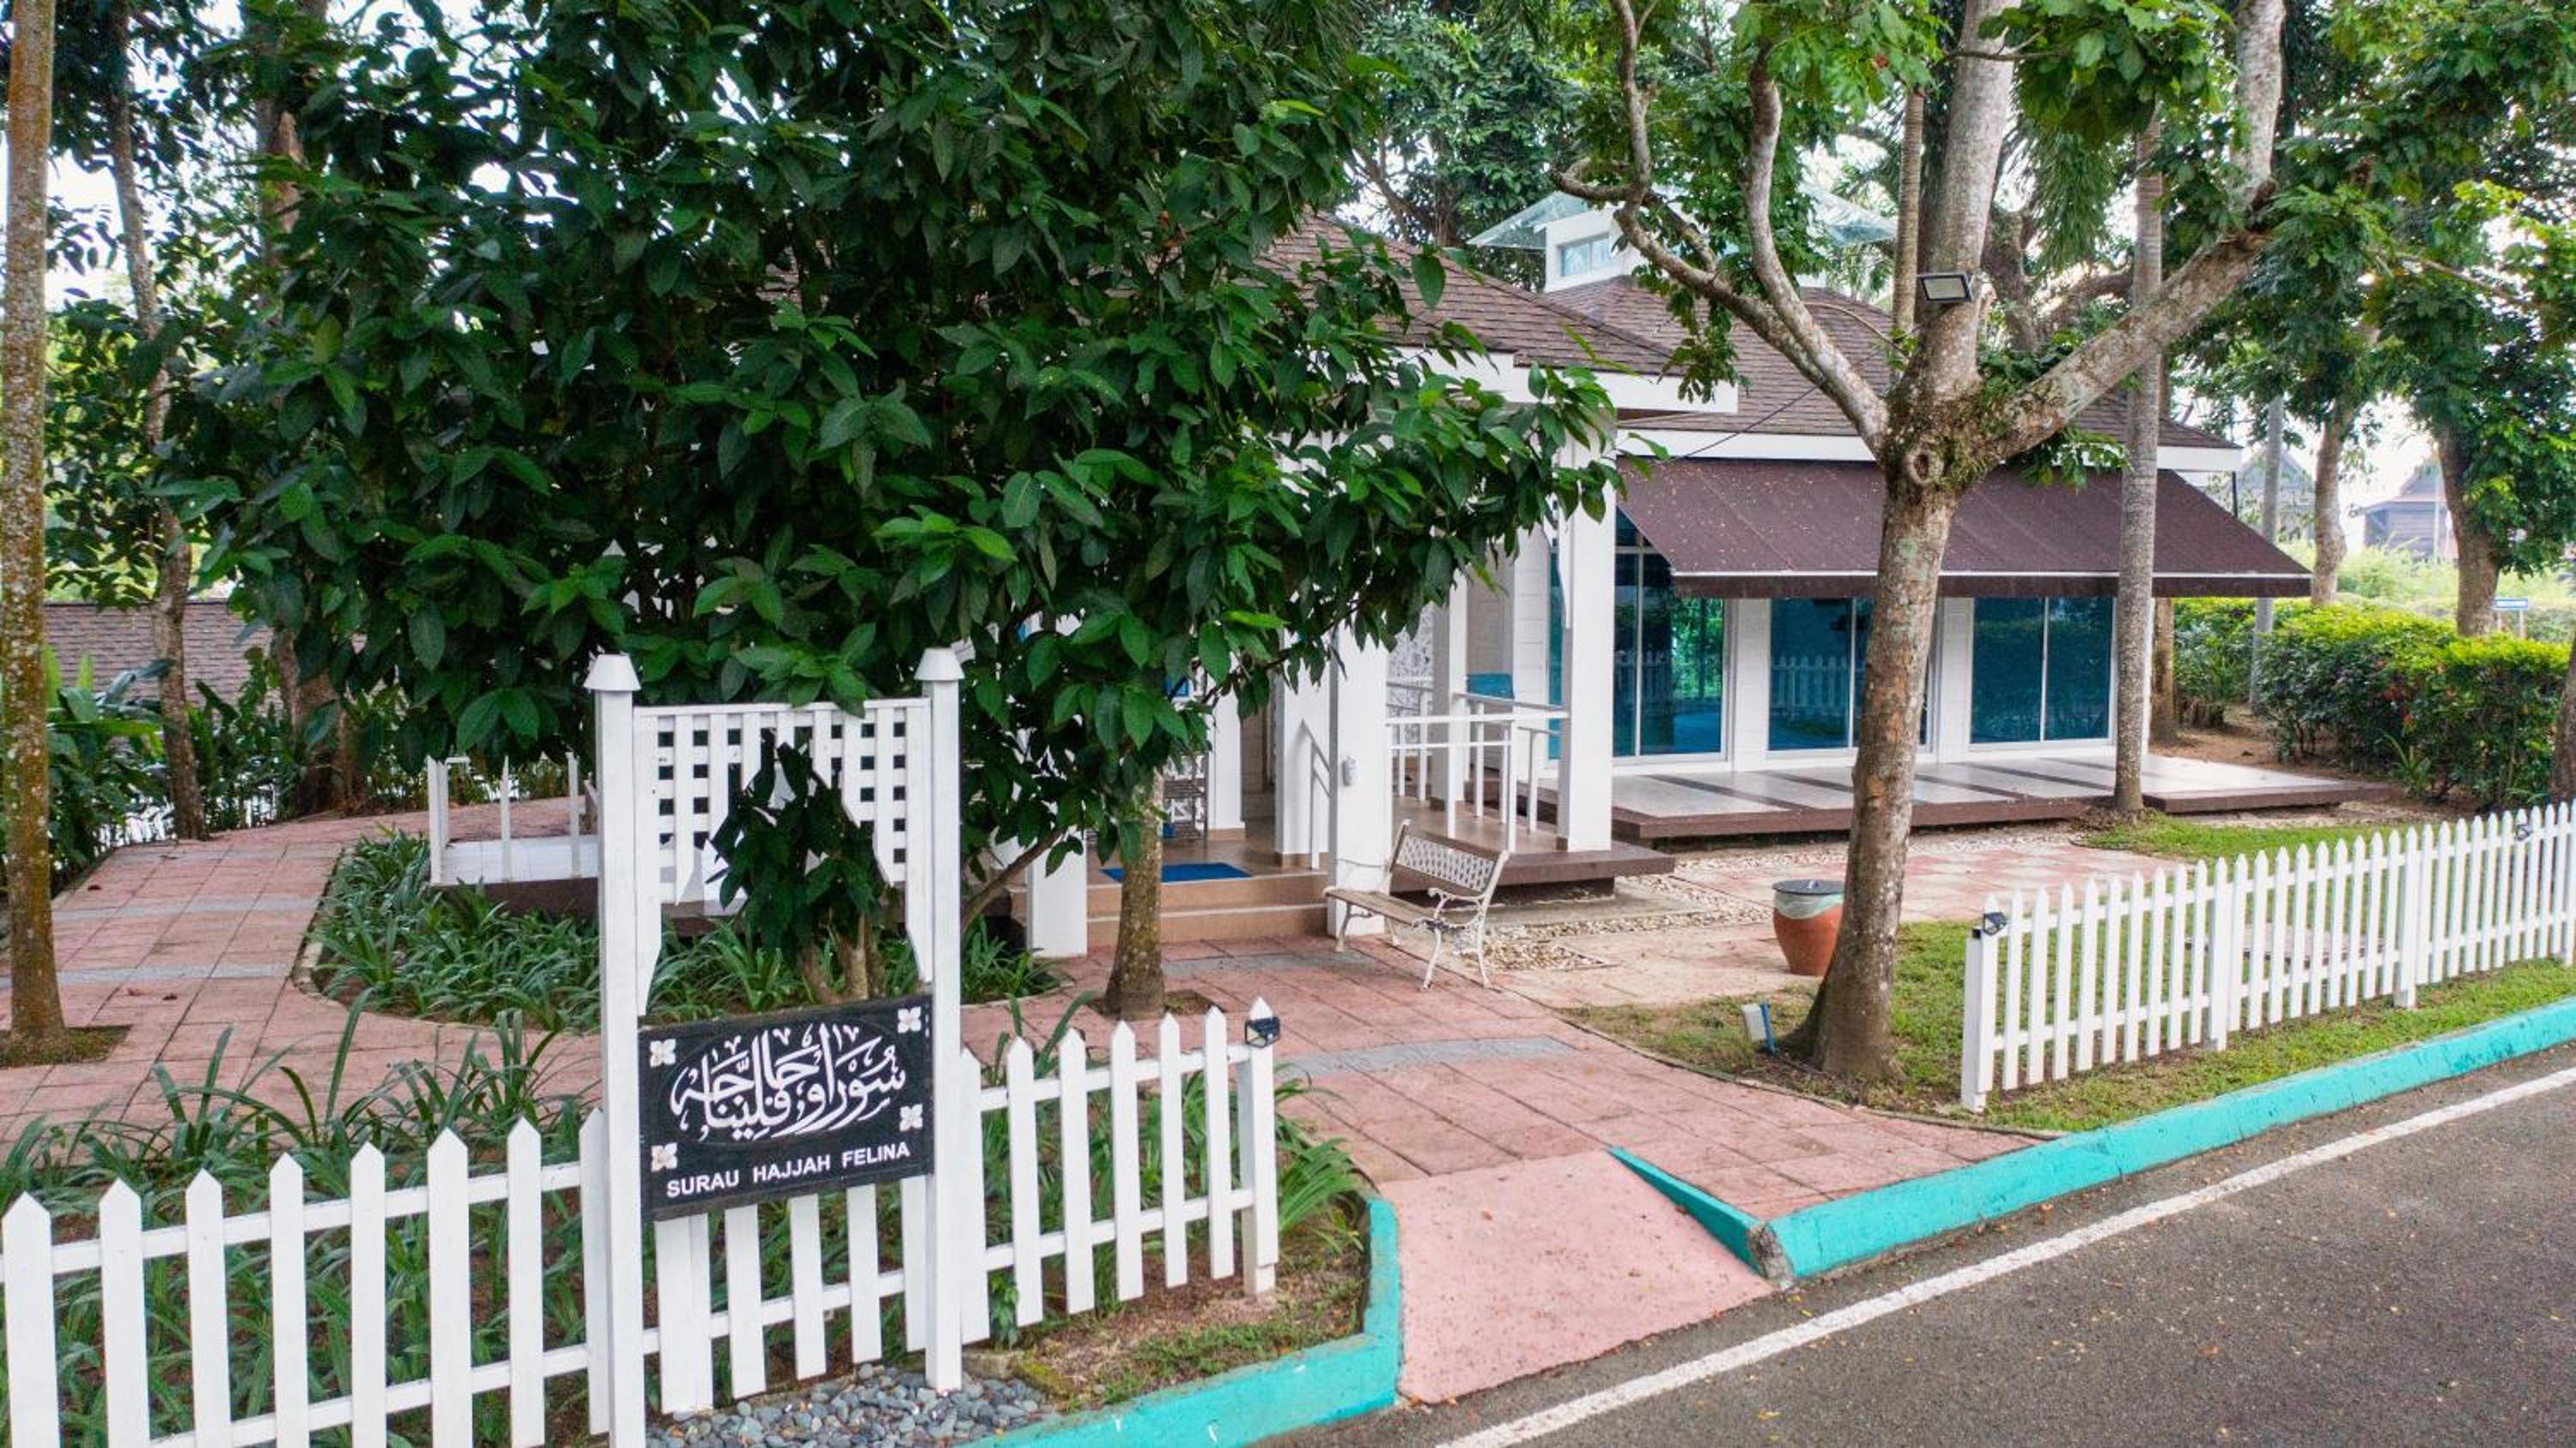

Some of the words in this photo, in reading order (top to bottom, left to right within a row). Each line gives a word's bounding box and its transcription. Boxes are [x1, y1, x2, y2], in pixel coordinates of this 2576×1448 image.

[667, 1171, 739, 1198] SURAU
[753, 1154, 830, 1183] HAJJAH
[842, 1141, 910, 1168] FELINA
